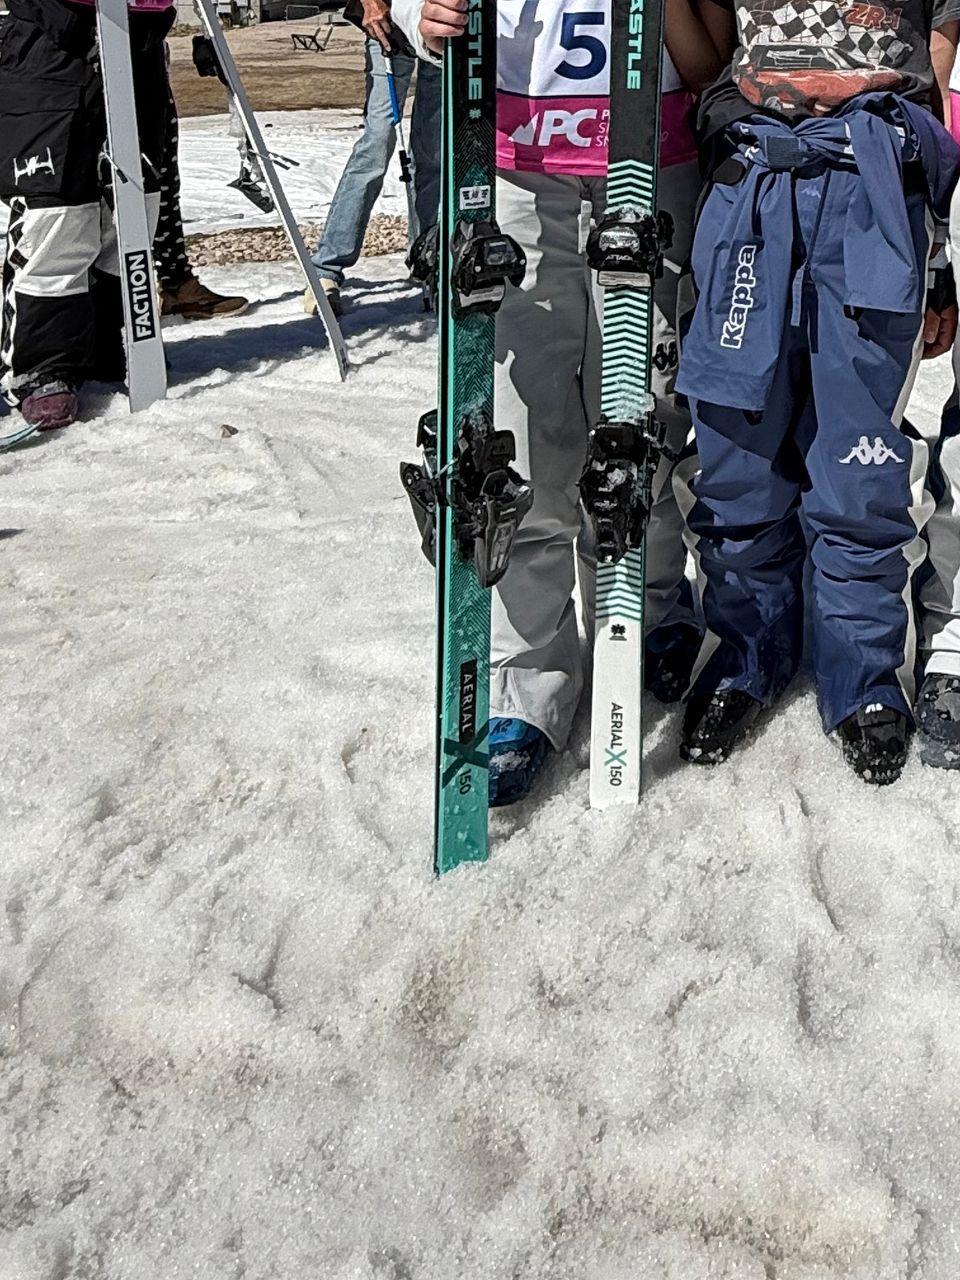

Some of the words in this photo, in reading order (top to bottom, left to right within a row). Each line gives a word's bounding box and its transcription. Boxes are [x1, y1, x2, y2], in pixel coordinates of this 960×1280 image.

[553, 11, 607, 81] 5
[538, 108, 598, 148] PC
[128, 253, 153, 338] FACTION
[720, 245, 757, 349] Kappa
[462, 672, 475, 733] AERIAL
[459, 768, 472, 796] 150
